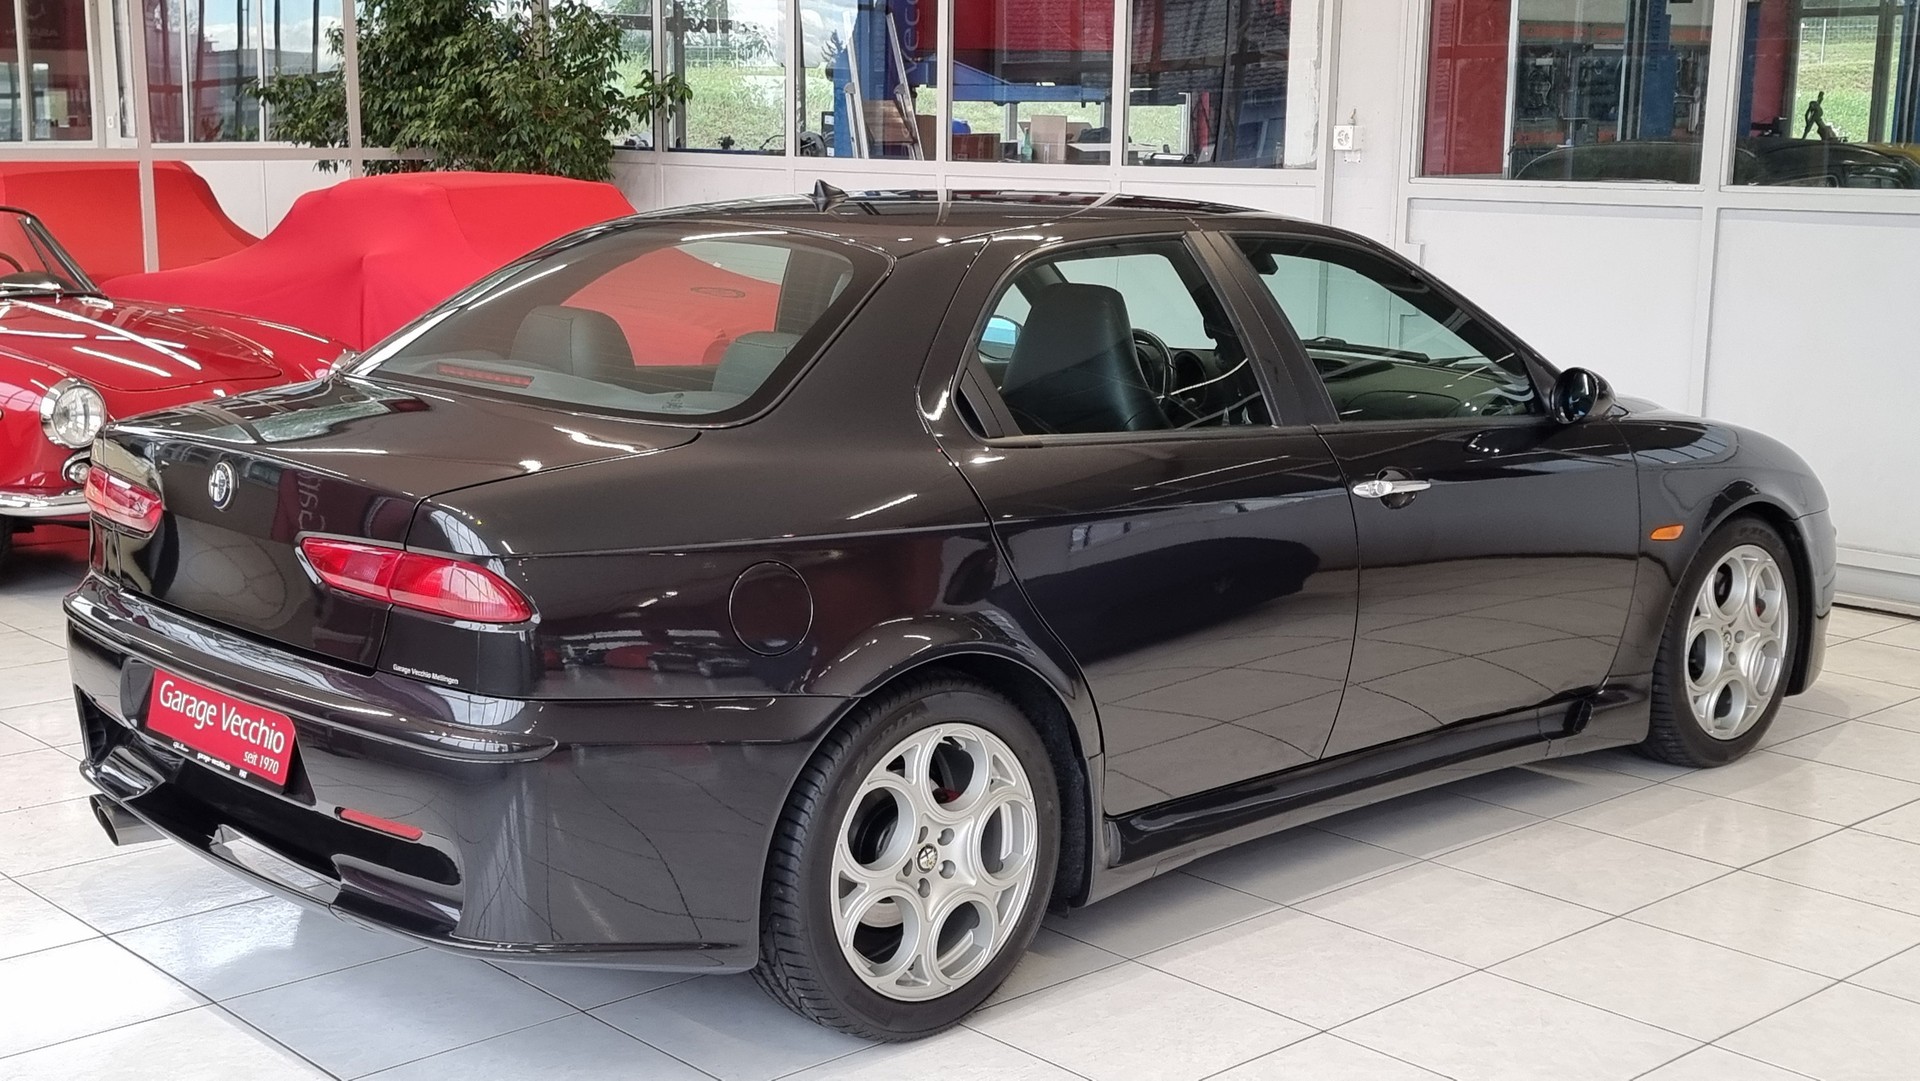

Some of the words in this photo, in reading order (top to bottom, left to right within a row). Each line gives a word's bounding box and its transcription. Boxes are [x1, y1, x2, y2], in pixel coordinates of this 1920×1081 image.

[160, 680, 217, 729] Garage
[222, 702, 285, 753] Vecchio
[243, 751, 258, 767] seit
[259, 755, 280, 775] 1970
